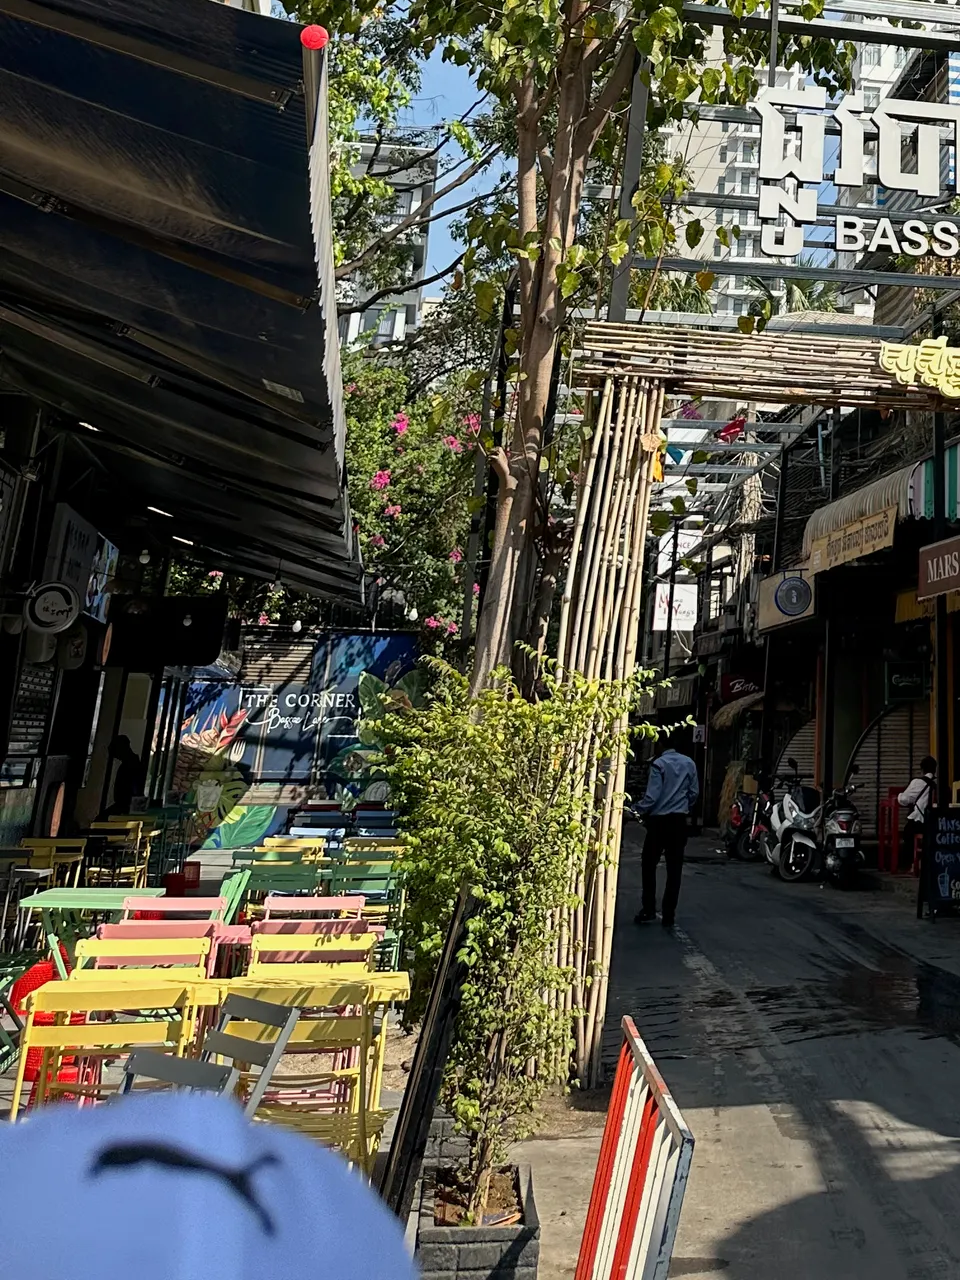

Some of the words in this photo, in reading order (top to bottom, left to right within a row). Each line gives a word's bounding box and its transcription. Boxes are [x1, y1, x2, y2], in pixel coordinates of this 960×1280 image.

[926, 553, 960, 583] MARS
[245, 694, 279, 708] THE
[285, 693, 356, 708] CORNER
